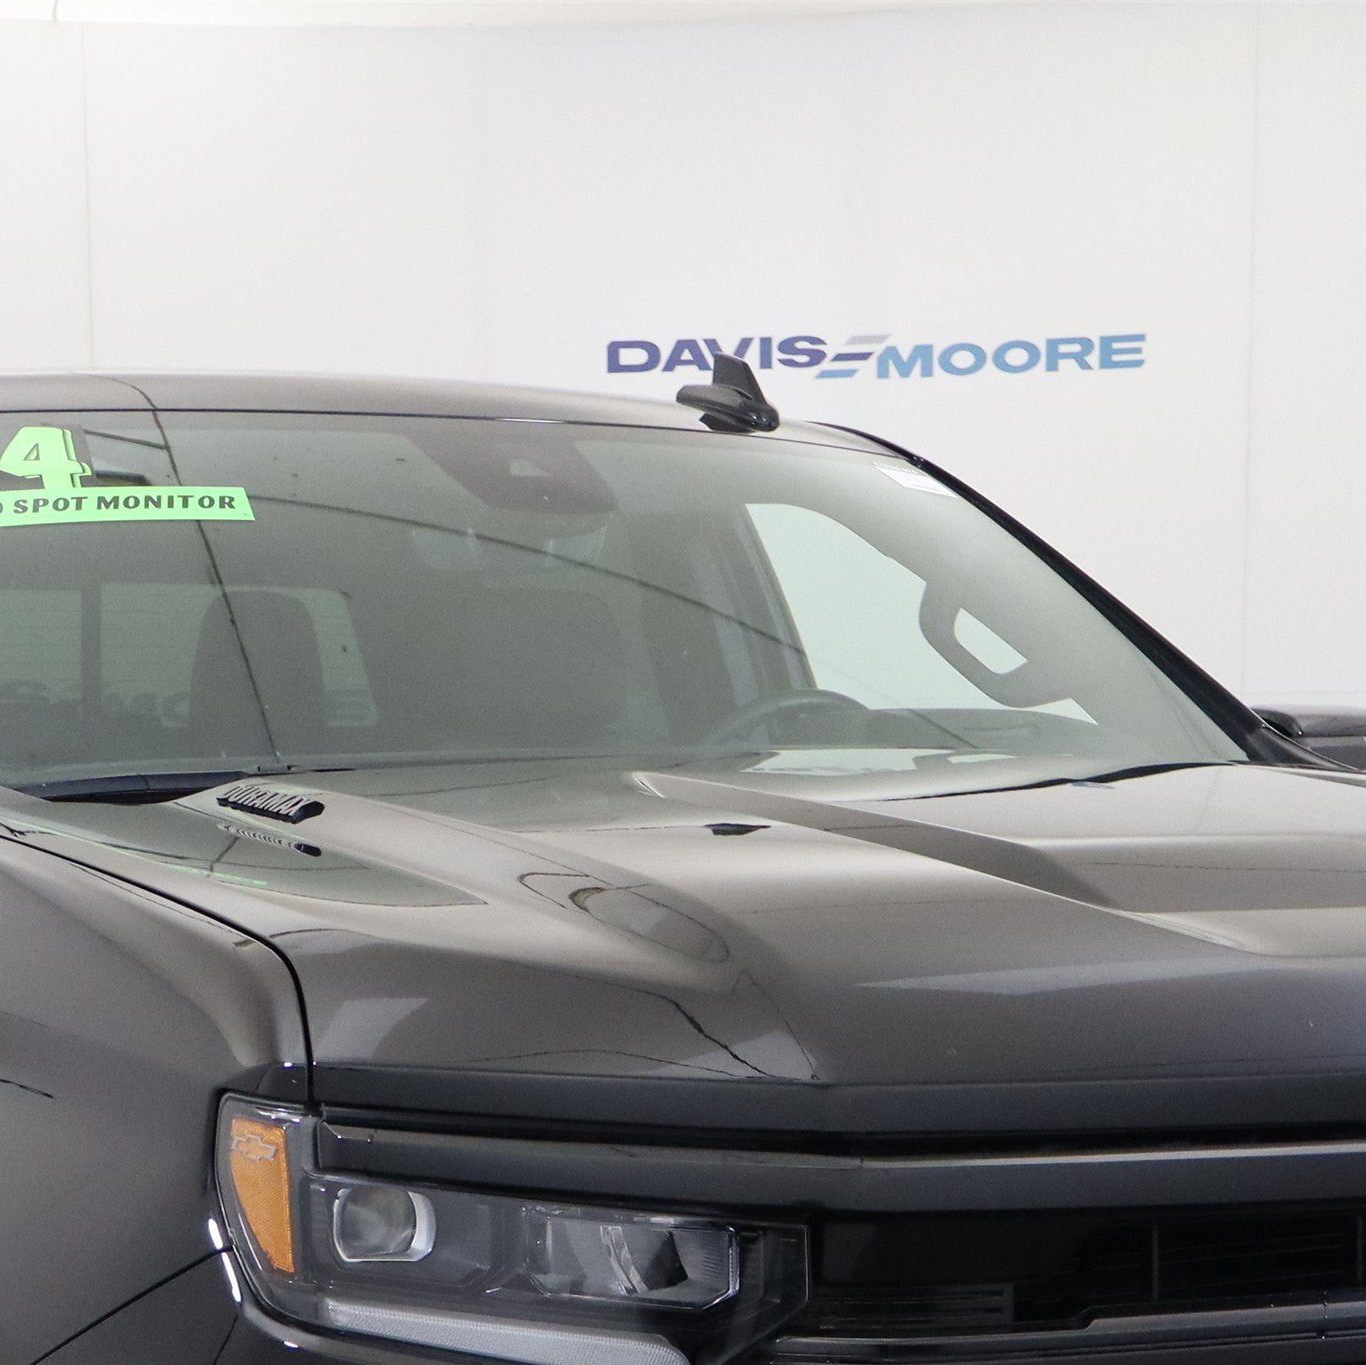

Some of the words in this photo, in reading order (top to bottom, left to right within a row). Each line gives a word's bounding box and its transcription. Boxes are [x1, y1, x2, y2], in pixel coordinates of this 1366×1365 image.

[876, 332, 1146, 379] MOORE
[13, 496, 89, 515] SPOT
[96, 495, 237, 510] MONITOR
